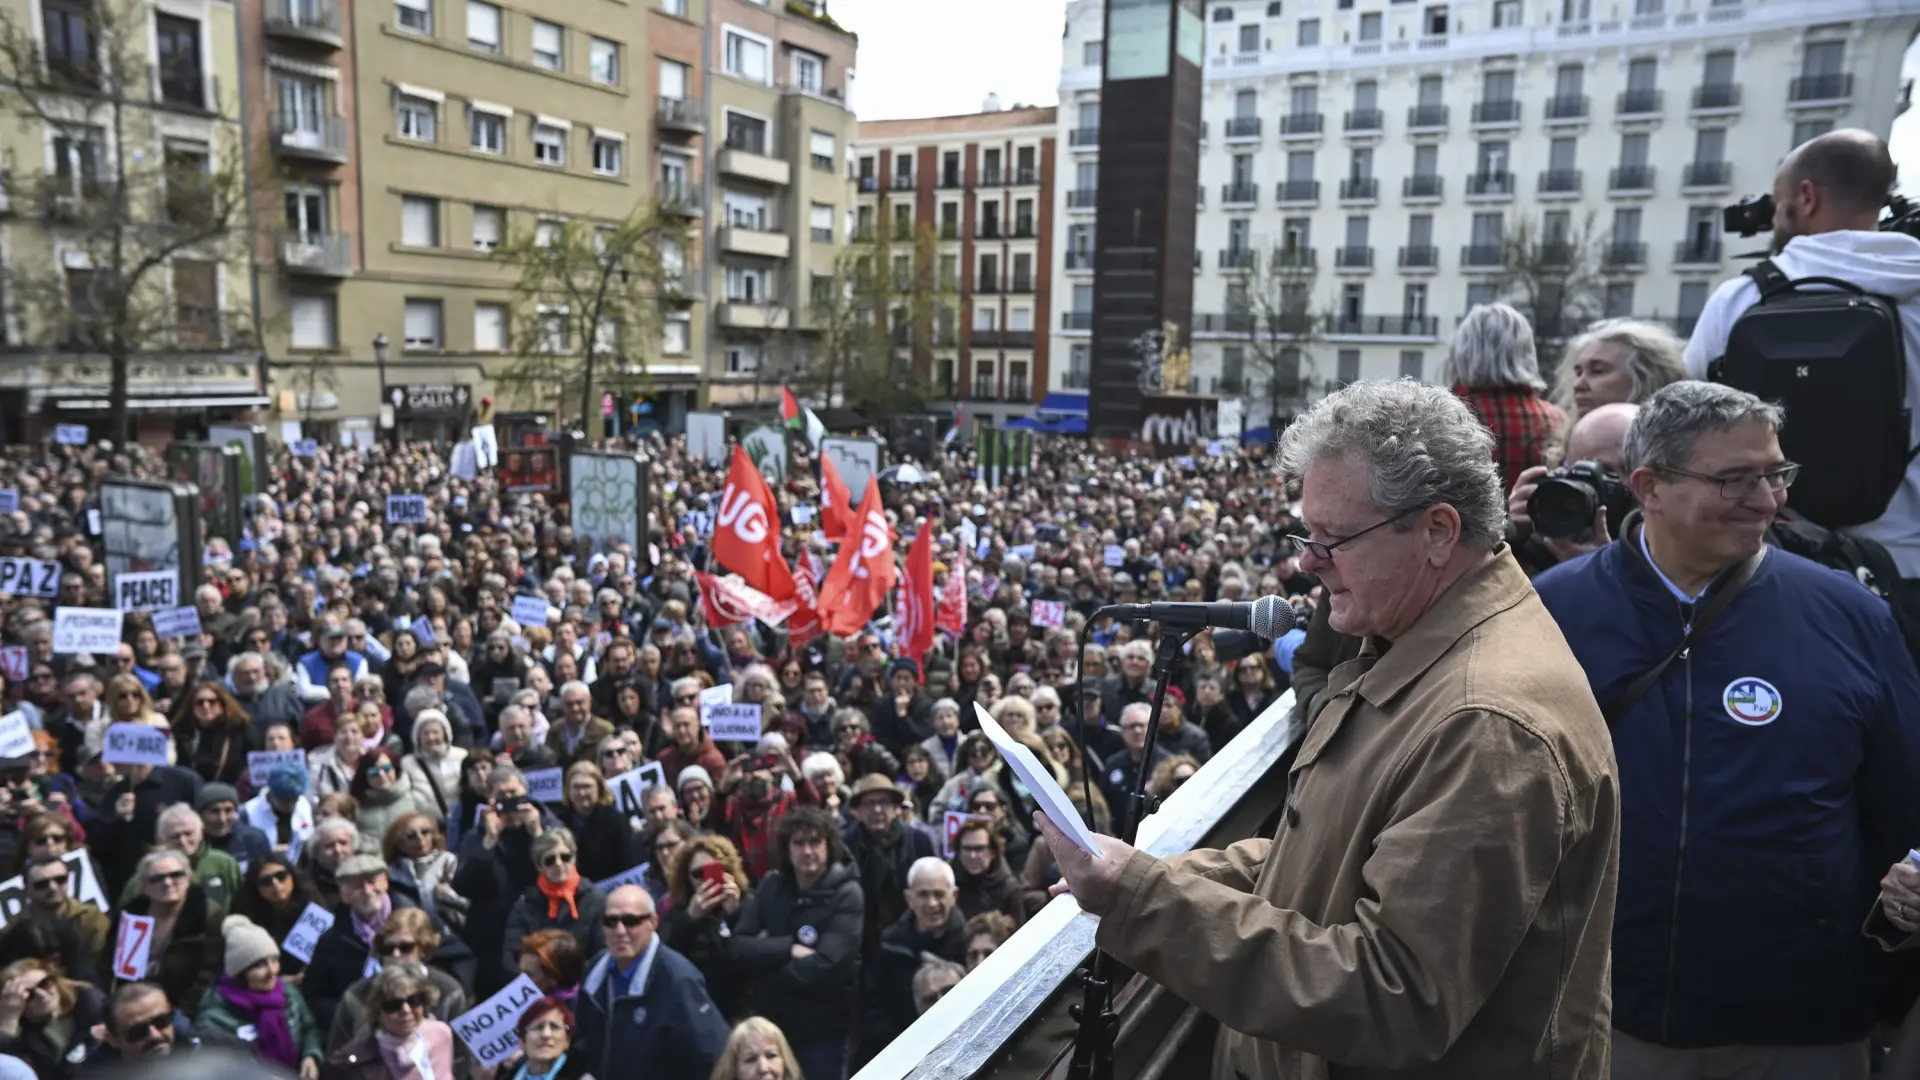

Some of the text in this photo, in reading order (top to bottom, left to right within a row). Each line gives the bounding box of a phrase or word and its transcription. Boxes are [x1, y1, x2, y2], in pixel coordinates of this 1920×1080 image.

[0, 561, 57, 593] PAZ
[121, 578, 172, 608] PEACE!
[461, 984, 537, 1043] ¡NO A LA
[478, 1026, 521, 1060] GUE
